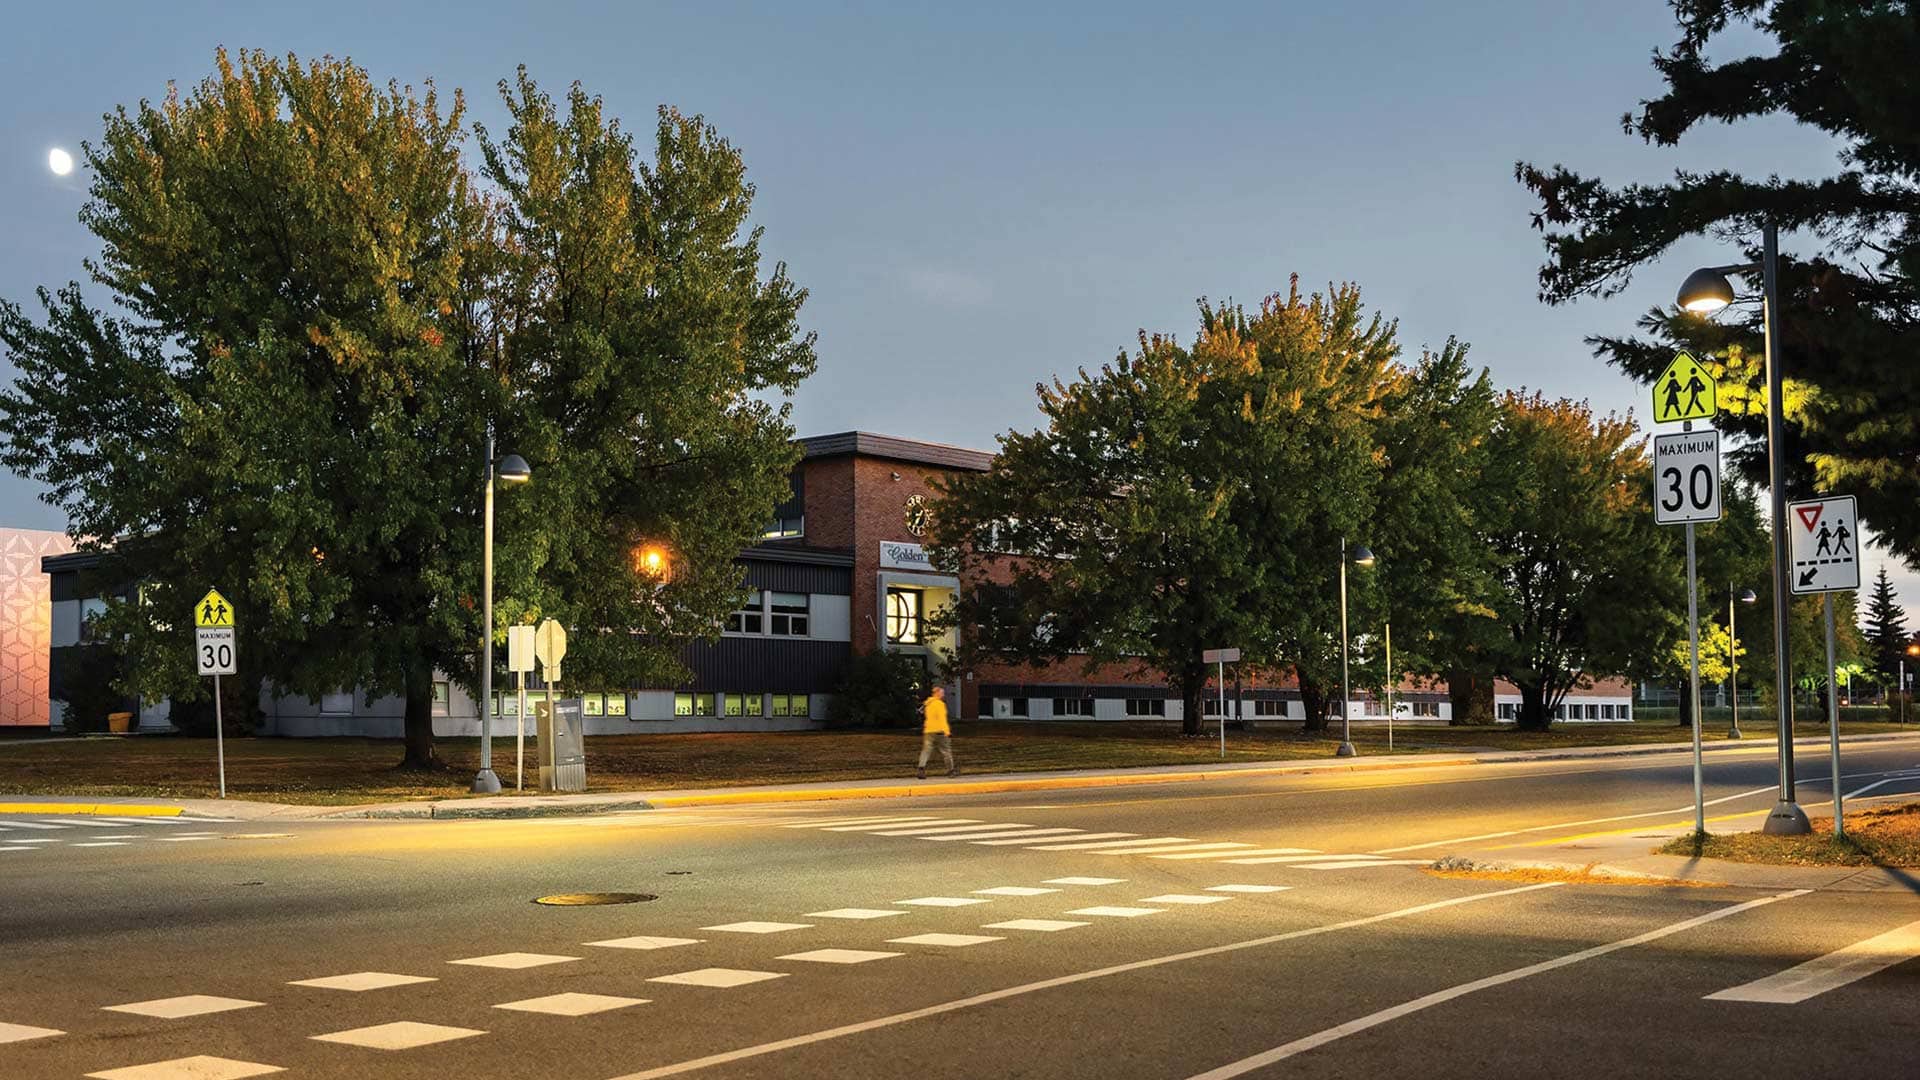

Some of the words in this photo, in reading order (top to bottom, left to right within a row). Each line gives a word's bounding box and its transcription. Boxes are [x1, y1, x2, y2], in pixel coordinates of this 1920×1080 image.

[1659, 441, 1714, 456] MAXIMUM
[1662, 464, 1713, 512] 30
[888, 546, 923, 564] Golden
[202, 644, 231, 668] 30
